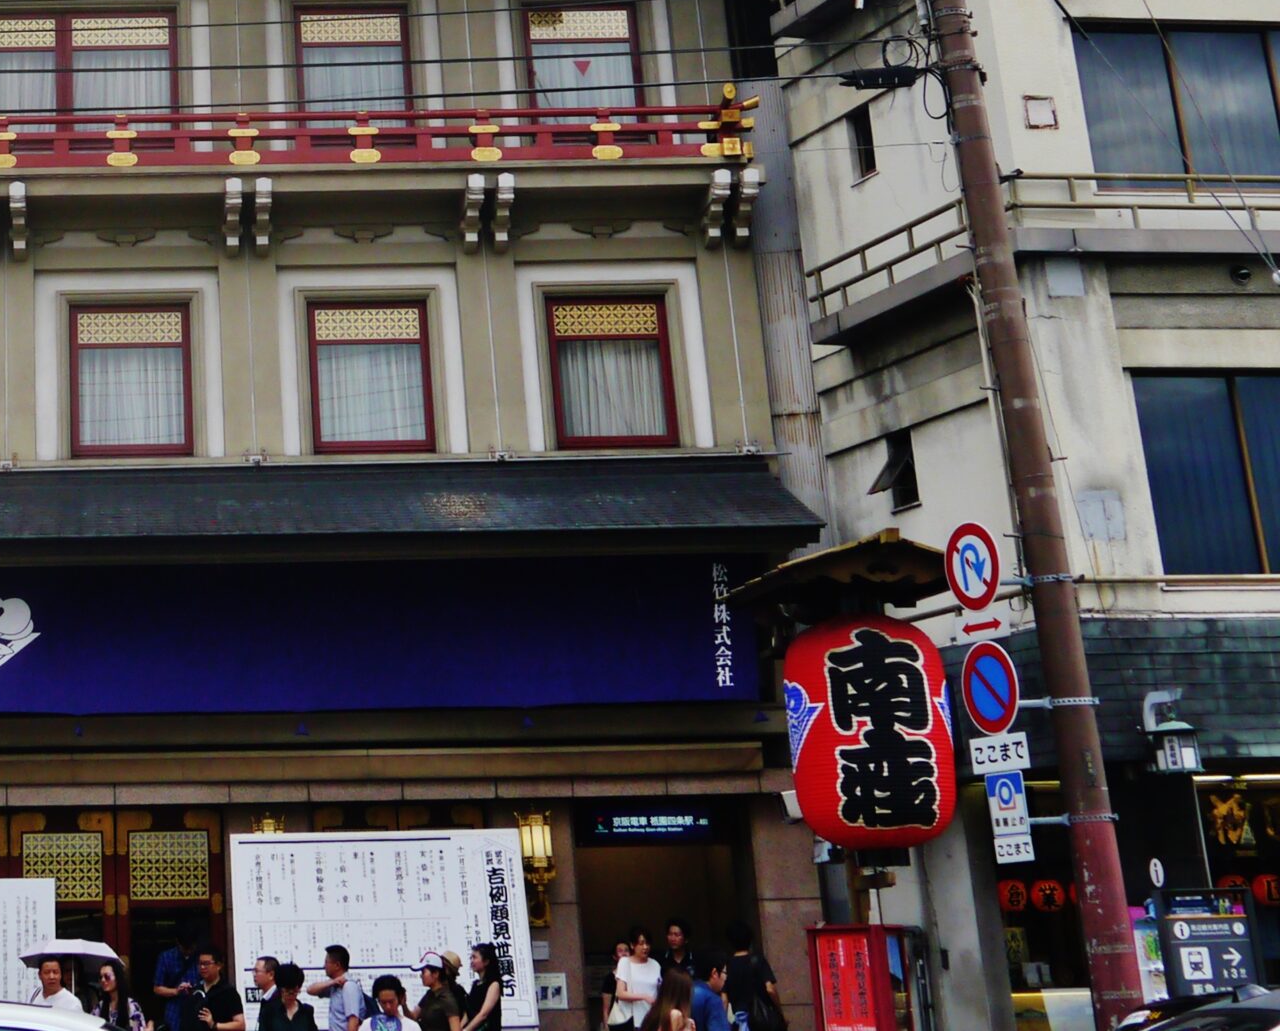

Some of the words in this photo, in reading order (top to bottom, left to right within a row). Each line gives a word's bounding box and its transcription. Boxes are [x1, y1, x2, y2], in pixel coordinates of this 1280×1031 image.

[712, 562, 735, 688] 松竹株式会社
[824, 626, 941, 830] 南座
[974, 740, 1025, 766] ここまで
[997, 841, 1031, 858] ここまで
